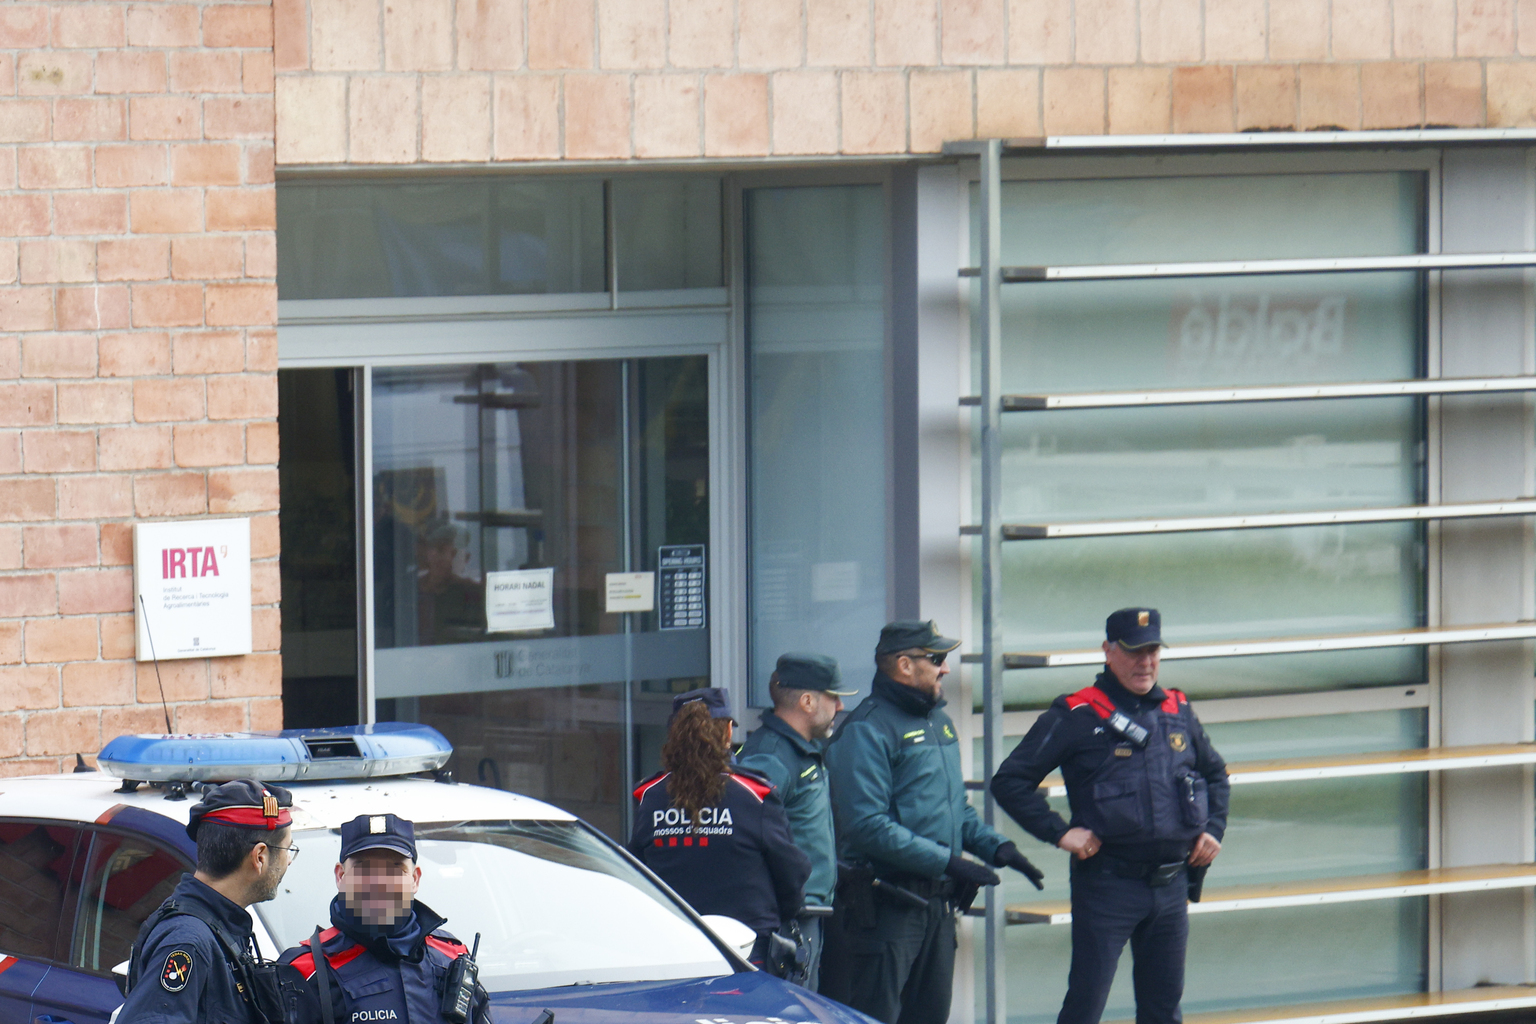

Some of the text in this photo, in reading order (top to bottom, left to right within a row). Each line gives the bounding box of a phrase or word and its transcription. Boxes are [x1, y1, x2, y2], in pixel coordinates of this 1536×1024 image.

[161, 546, 220, 580] IRTA
[493, 581, 546, 592] HORARI NADAL
[199, 591, 230, 600] Tecnologia
[653, 806, 733, 828] POLCIA
[653, 826, 684, 837] mossos
[351, 1009, 398, 1023] POLICIA
